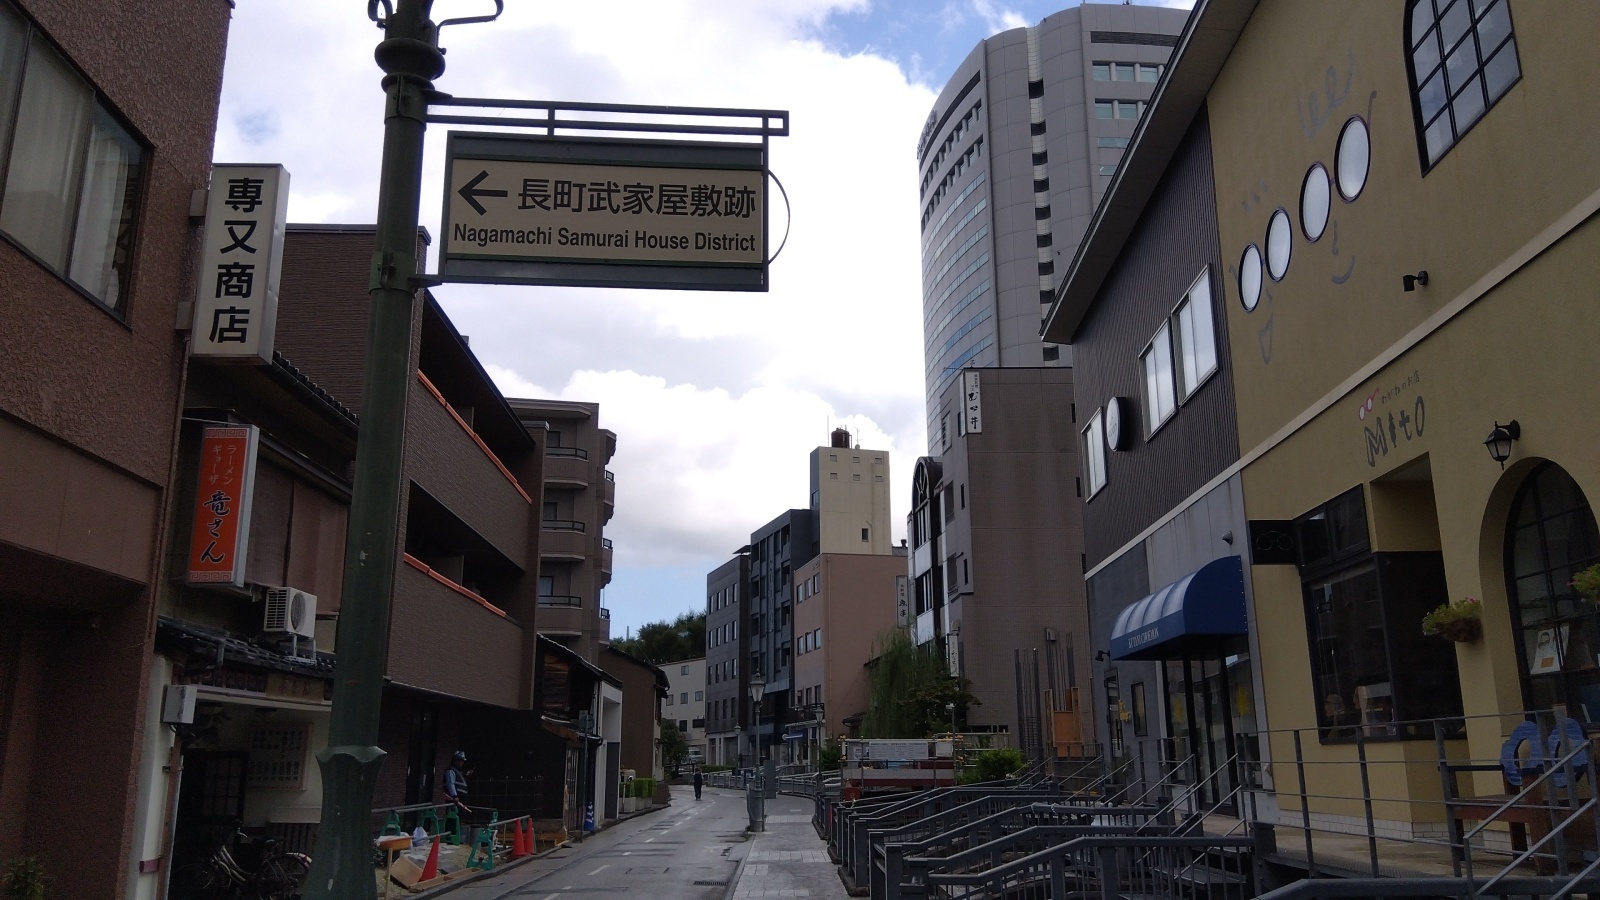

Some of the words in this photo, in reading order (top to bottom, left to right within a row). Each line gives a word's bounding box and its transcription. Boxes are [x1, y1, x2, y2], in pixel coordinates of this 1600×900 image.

[517, 178, 757, 219] 長町武家屋敷跡
[453, 223, 552, 248] Nagamachi
[558, 227, 629, 248] Samurai
[634, 230, 689, 250] House
[694, 231, 756, 251] District
[208, 177, 265, 343] 専又商店
[208, 444, 223, 485] ギョーザ
[223, 444, 237, 485] ラーメン
[201, 490, 231, 563] 竜さん
